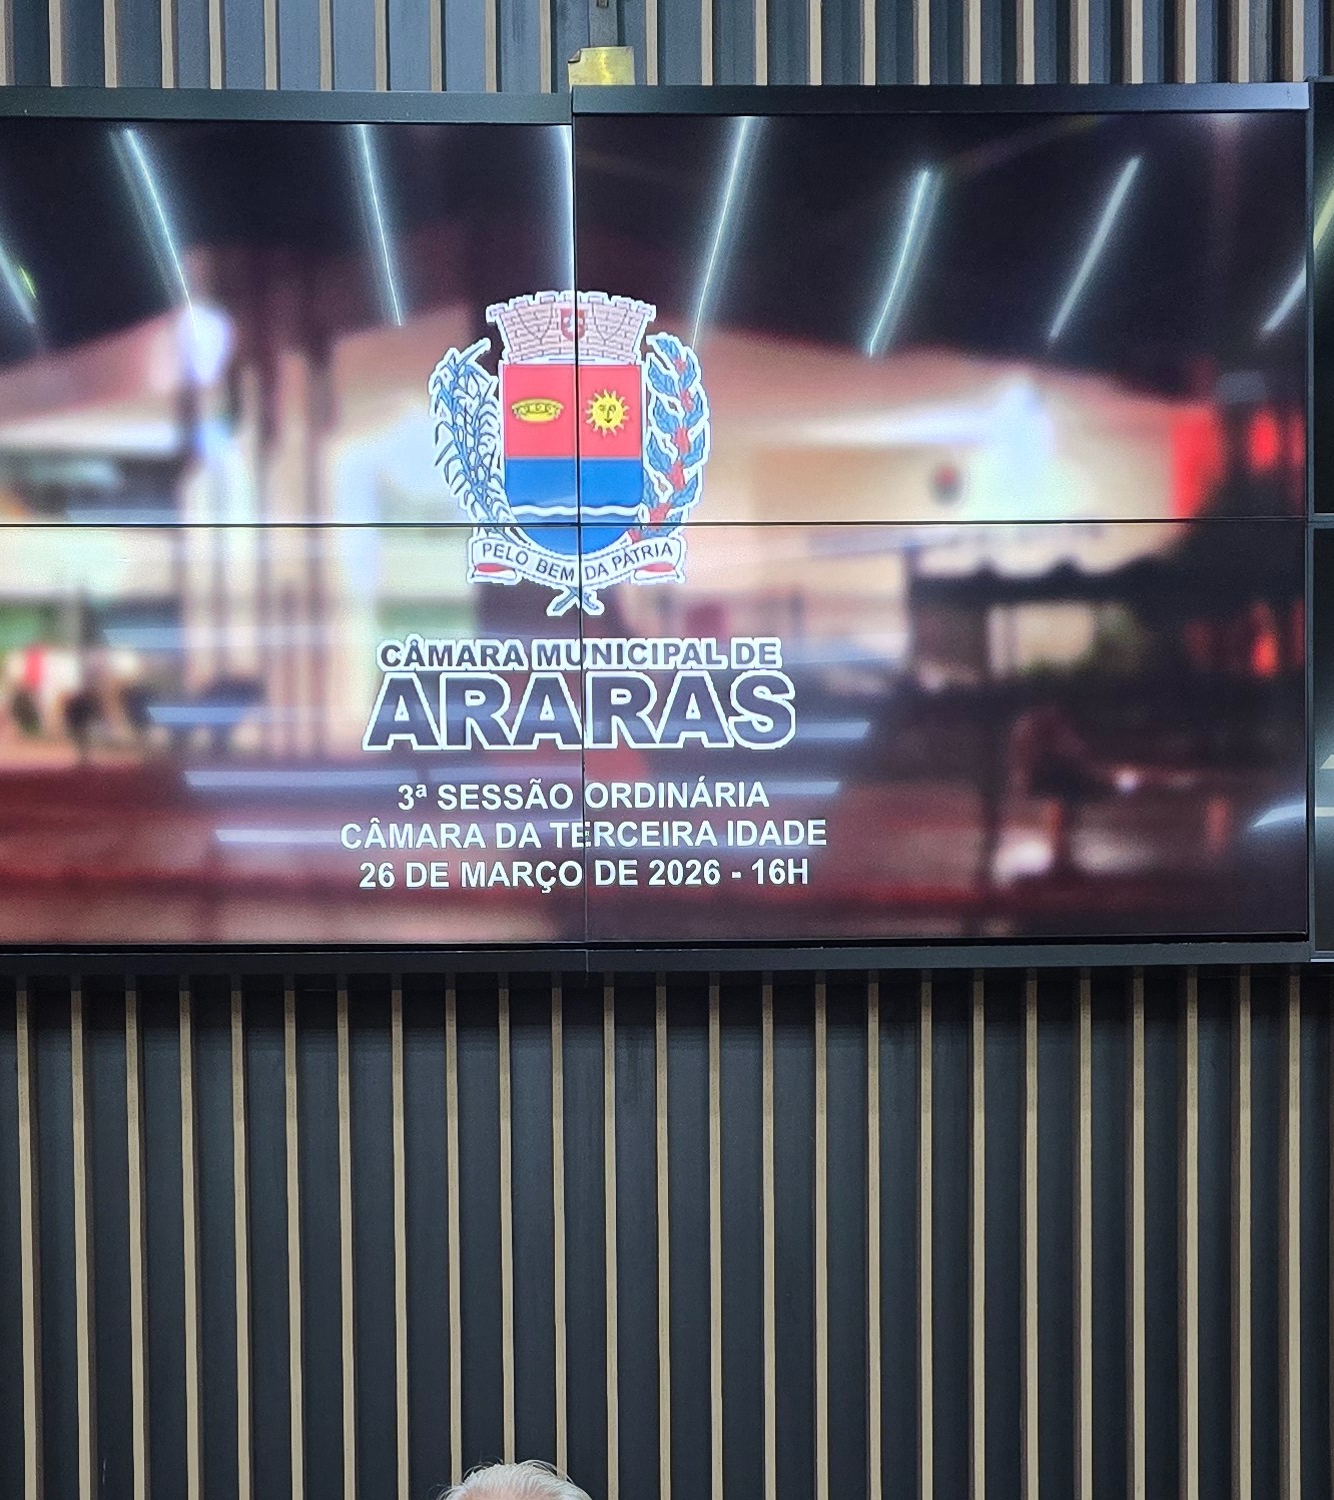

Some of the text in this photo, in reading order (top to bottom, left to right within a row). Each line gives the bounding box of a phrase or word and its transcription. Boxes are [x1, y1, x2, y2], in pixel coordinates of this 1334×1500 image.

[482, 541, 529, 566] PELO
[535, 559, 575, 582] BEM
[584, 563, 610, 581] DA
[378, 636, 780, 669] CÂMARA MUNICIPAL DE
[363, 671, 796, 750] ARARAS
[398, 776, 770, 810] 3ª SESSÃO ORDINÁRIA
[340, 817, 827, 849] CÂMARA DA TERCEIRA IDADE
[359, 862, 396, 889] 26
[406, 862, 448, 889] DE
[461, 860, 583, 893] MARÇO
[595, 860, 639, 886] DE
[648, 859, 720, 886] 2026
[751, 858, 809, 885] 16H
